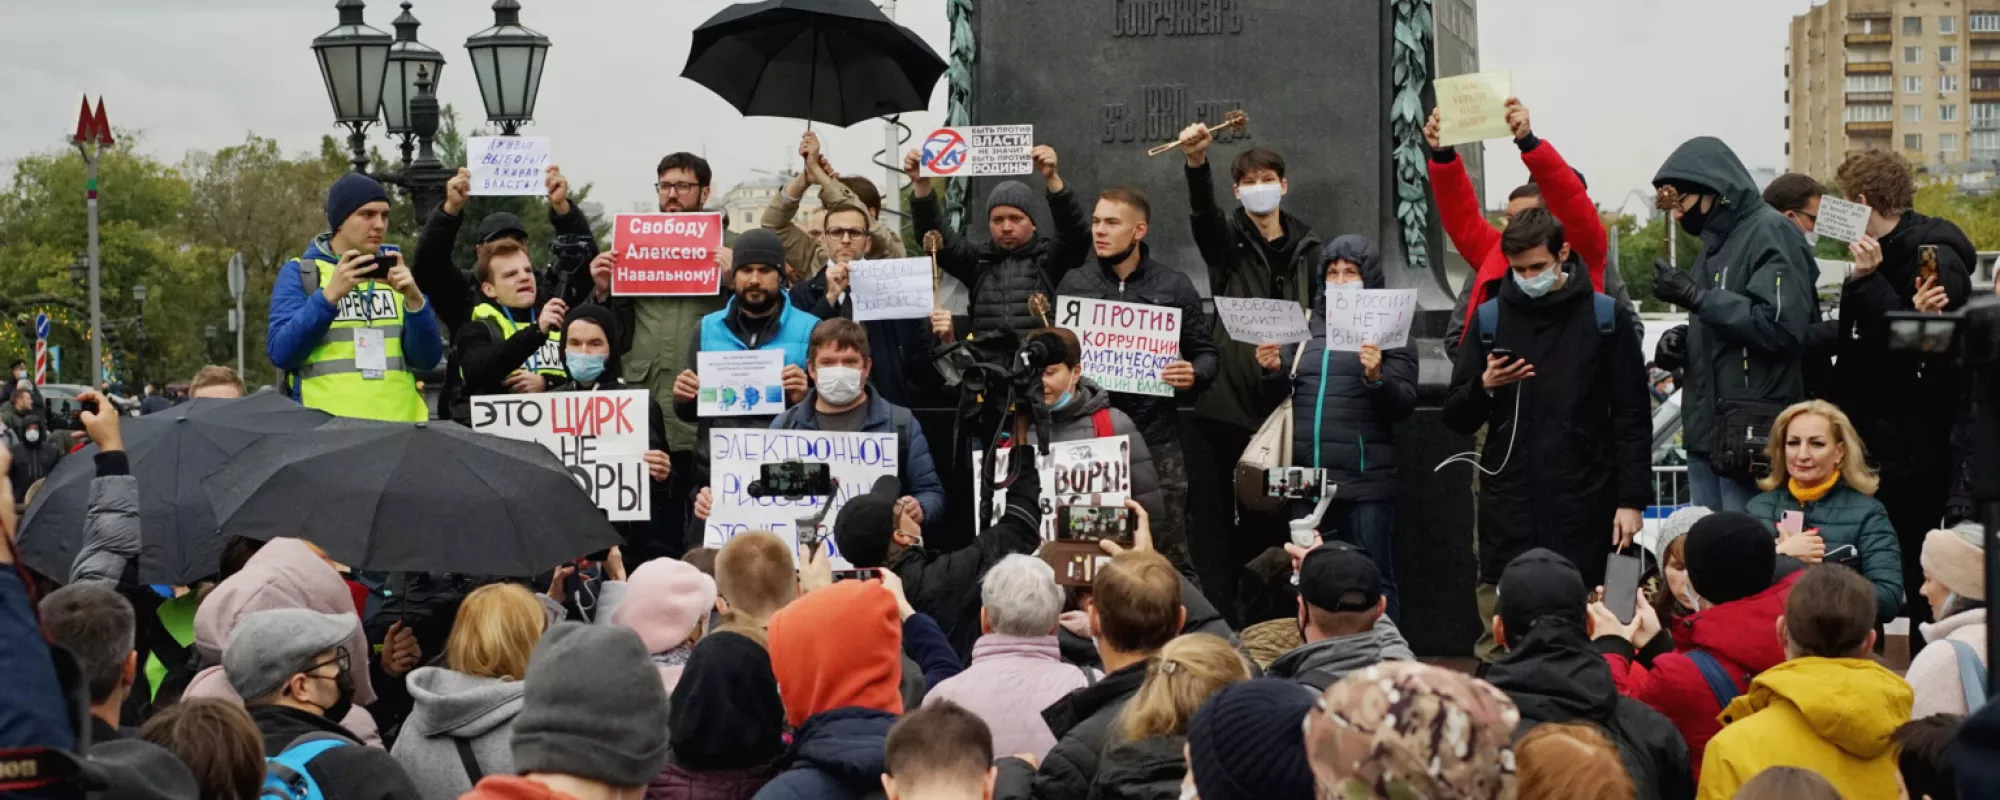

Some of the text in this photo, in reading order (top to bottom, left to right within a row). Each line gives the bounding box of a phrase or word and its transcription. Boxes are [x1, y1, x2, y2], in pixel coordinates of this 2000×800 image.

[973, 136, 1030, 146] ВЛАСТИ
[973, 163, 1030, 173] РОДИНЫ
[629, 218, 709, 238] Свободу
[625, 243, 708, 260] Алексею
[617, 267, 716, 285] Навальному!
[339, 293, 394, 318] РЕССА
[1221, 298, 1294, 312] СВОБОДУ
[1335, 292, 1412, 309] В РОССИИ
[1062, 300, 1175, 332] Я ПРОТИВ
[1352, 311, 1390, 328] НЕТ
[1083, 330, 1178, 355] КОРРУПЦИИ
[1083, 362, 1156, 380] РРОРИЗМА
[474, 396, 635, 436] ЭТО ЦИРК
[561, 435, 597, 466] НЕ
[714, 433, 897, 468] ЭЛЕКТРОННОЕ
[1055, 440, 1129, 494] ВОРЫ!
